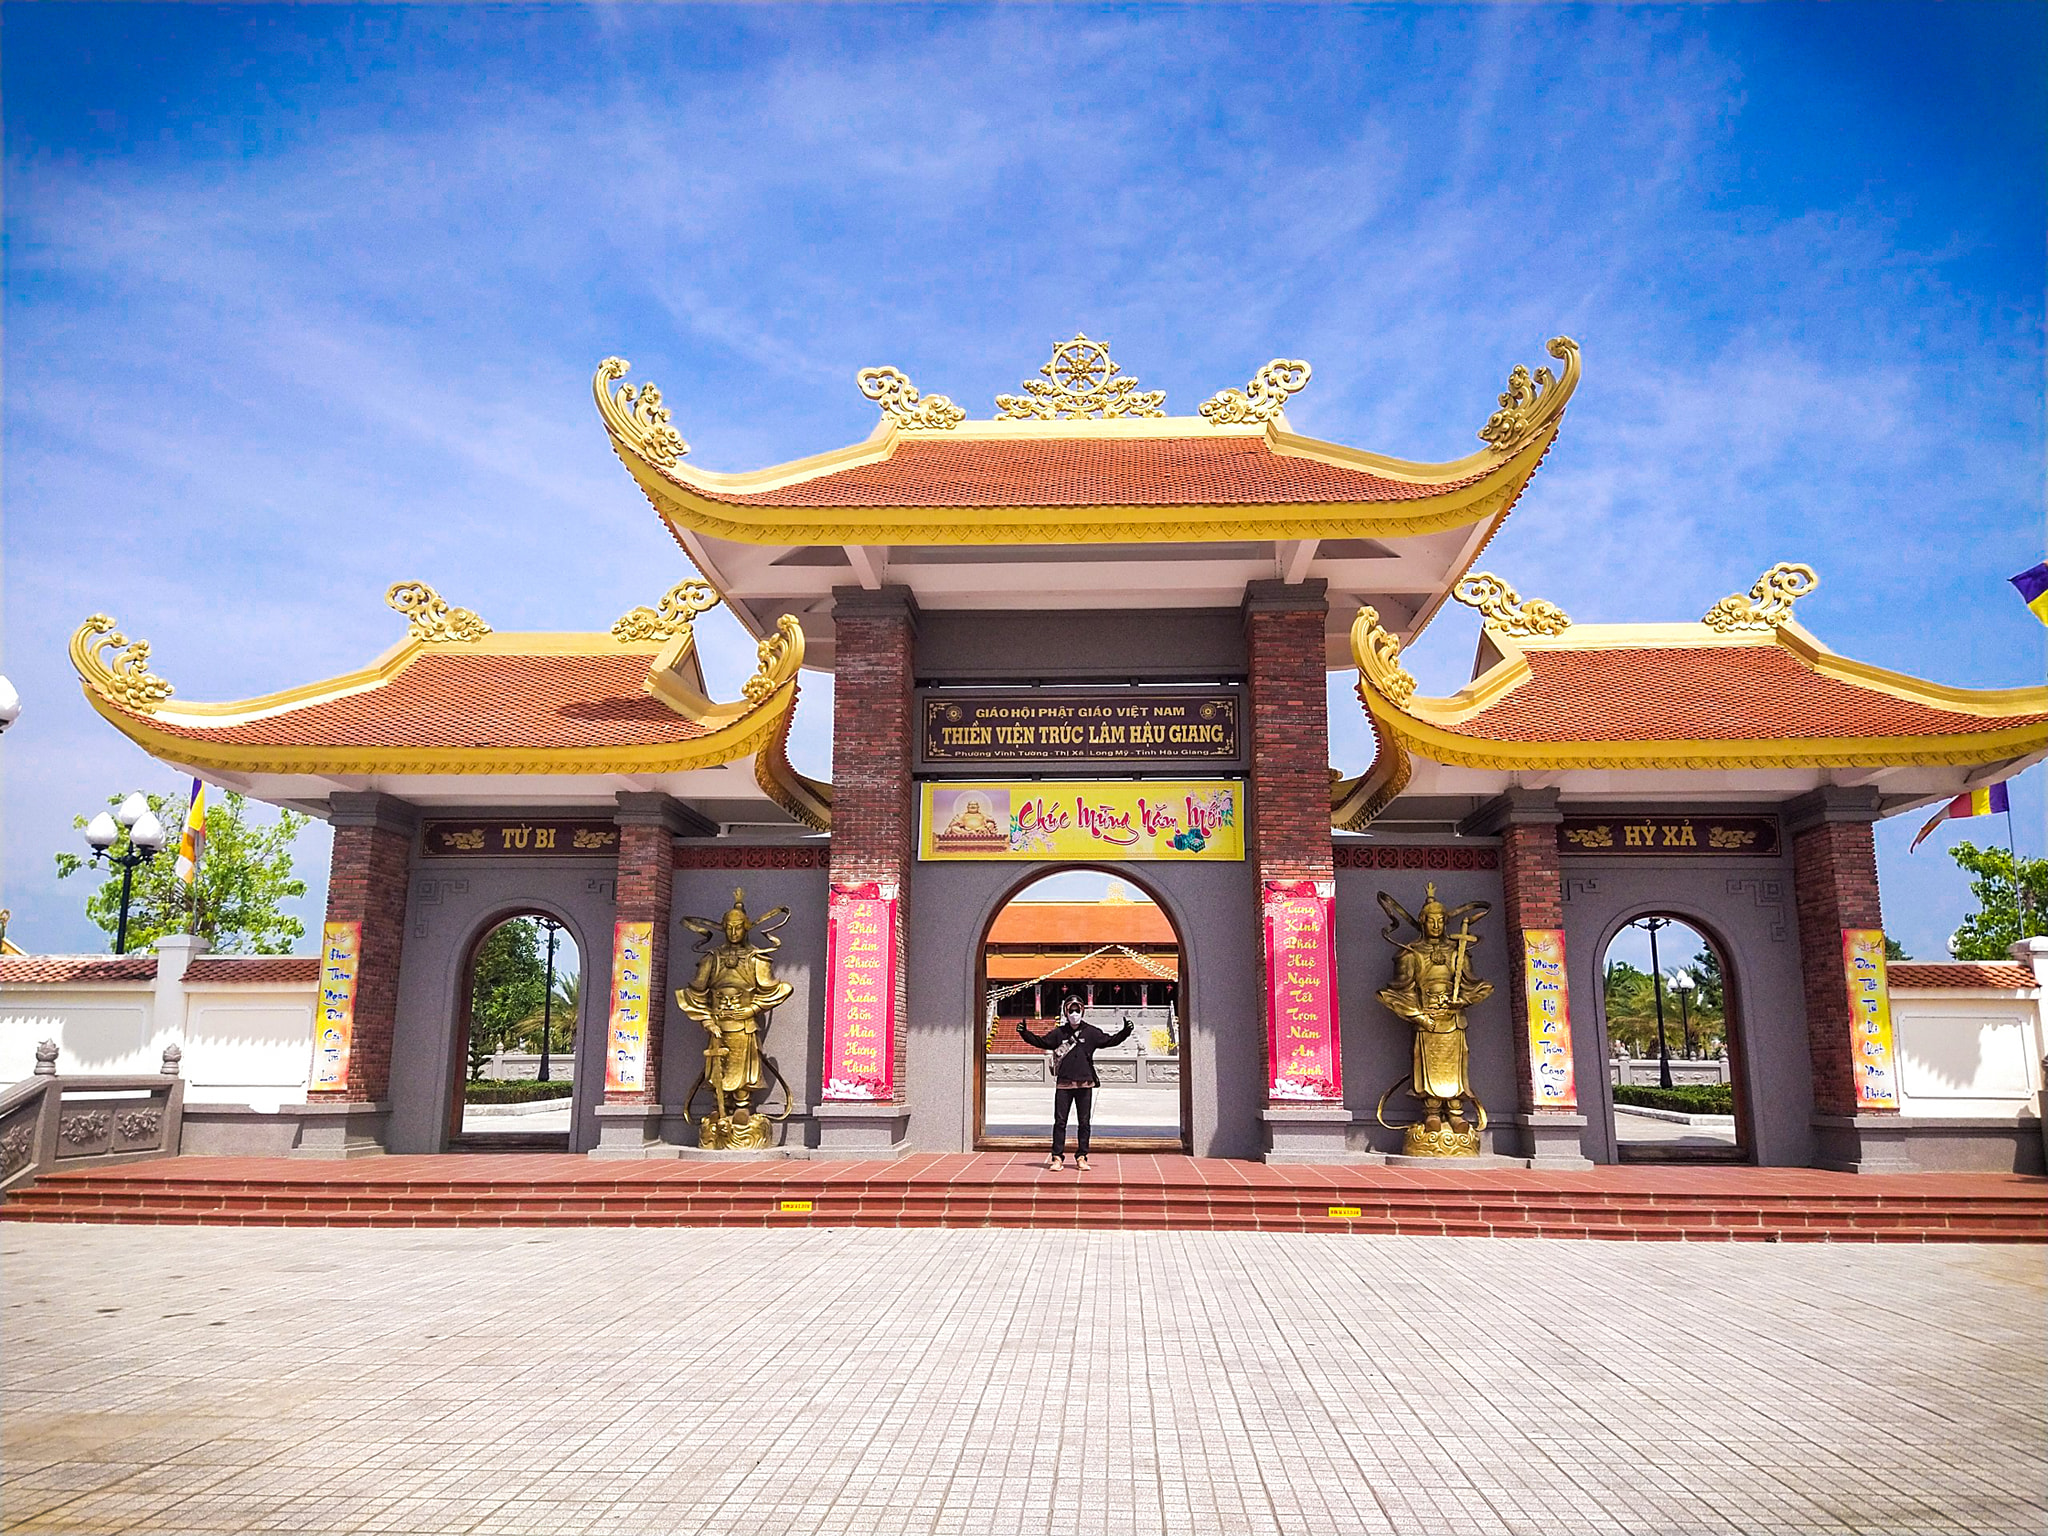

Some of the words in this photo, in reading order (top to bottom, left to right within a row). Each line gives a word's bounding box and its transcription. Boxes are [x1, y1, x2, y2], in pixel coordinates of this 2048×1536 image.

[975, 706, 1009, 718] GIÁO
[1011, 706, 1036, 720] HỘI
[1038, 706, 1075, 719] PHẬT
[1078, 705, 1113, 717] GIÁO
[1116, 705, 1149, 719] VIỆT
[1153, 707, 1185, 717] NAM
[941, 720, 993, 745] THIỀN
[995, 721, 1035, 748] VIỆN
[1038, 721, 1084, 744] TRÚC
[1088, 720, 1126, 744] LÂM
[1129, 720, 1166, 747] HẬU
[1168, 724, 1225, 743] GIANG
[1089, 749, 1114, 757] Long
[1180, 749, 1210, 757] Giang
[1018, 798, 1072, 832] Chúc
[1076, 796, 1140, 846] Mừng
[1137, 798, 1181, 837] Năm
[1184, 796, 1223, 838] Mới
[501, 823, 533, 849] TỪ
[534, 828, 556, 849] BI
[1623, 818, 1657, 846] HỶ
[1661, 818, 1697, 846] XẢ
[847, 921, 878, 937] Phật
[1283, 918, 1320, 932] Kinh
[1283, 936, 1318, 949] Phát
[1287, 953, 1317, 970] Huệ
[1283, 971, 1321, 988] Ngày
[844, 988, 878, 1003] Xuân
[1289, 989, 1314, 1003] Tết
[1286, 1007, 1318, 1023] Trọn
[843, 1023, 876, 1038] Mùa
[1286, 1025, 1322, 1039] Năm
[844, 1041, 877, 1059] Hưng
[1291, 1043, 1315, 1057] An
[1285, 1061, 1324, 1076] Lành
